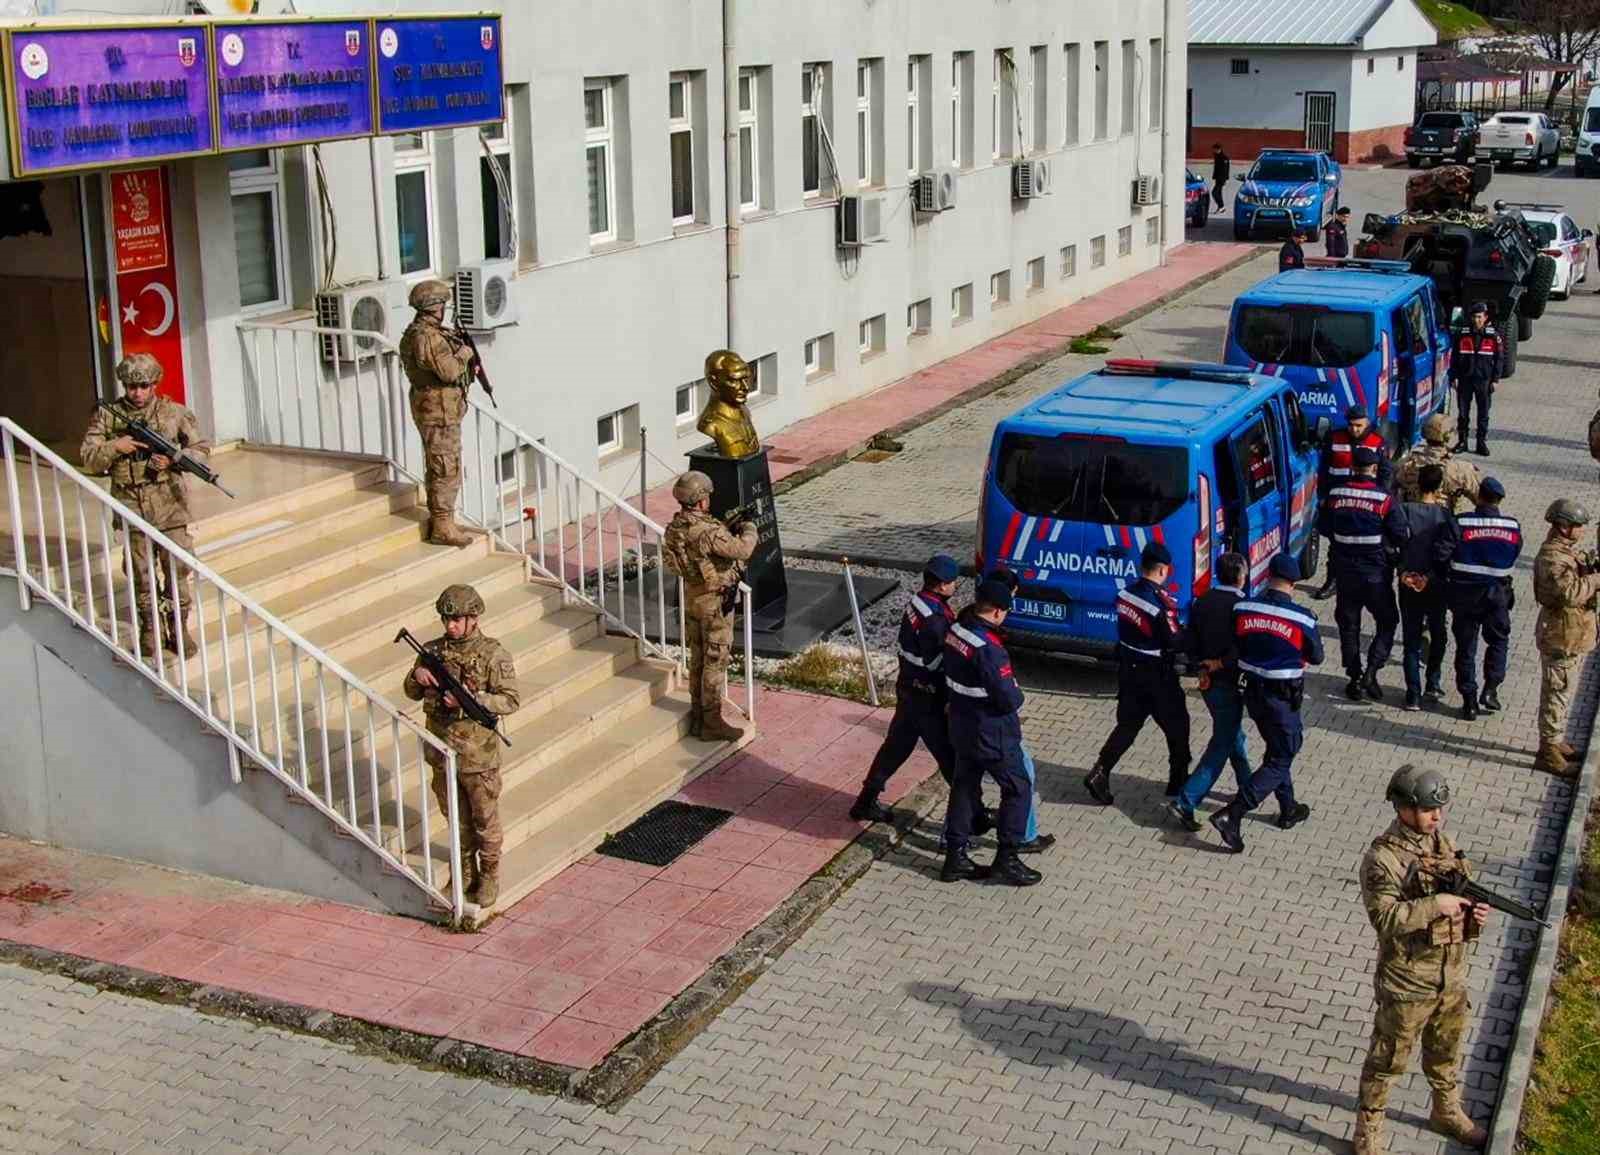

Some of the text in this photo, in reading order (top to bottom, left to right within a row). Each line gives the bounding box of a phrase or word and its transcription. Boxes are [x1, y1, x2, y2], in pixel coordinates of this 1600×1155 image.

[1292, 390, 1338, 407] ARMA
[1034, 549, 1138, 578] JANDARMA
[1022, 600, 1040, 614] JAA
[1043, 604, 1062, 617] 040
[1243, 616, 1294, 639] JANDARMA
